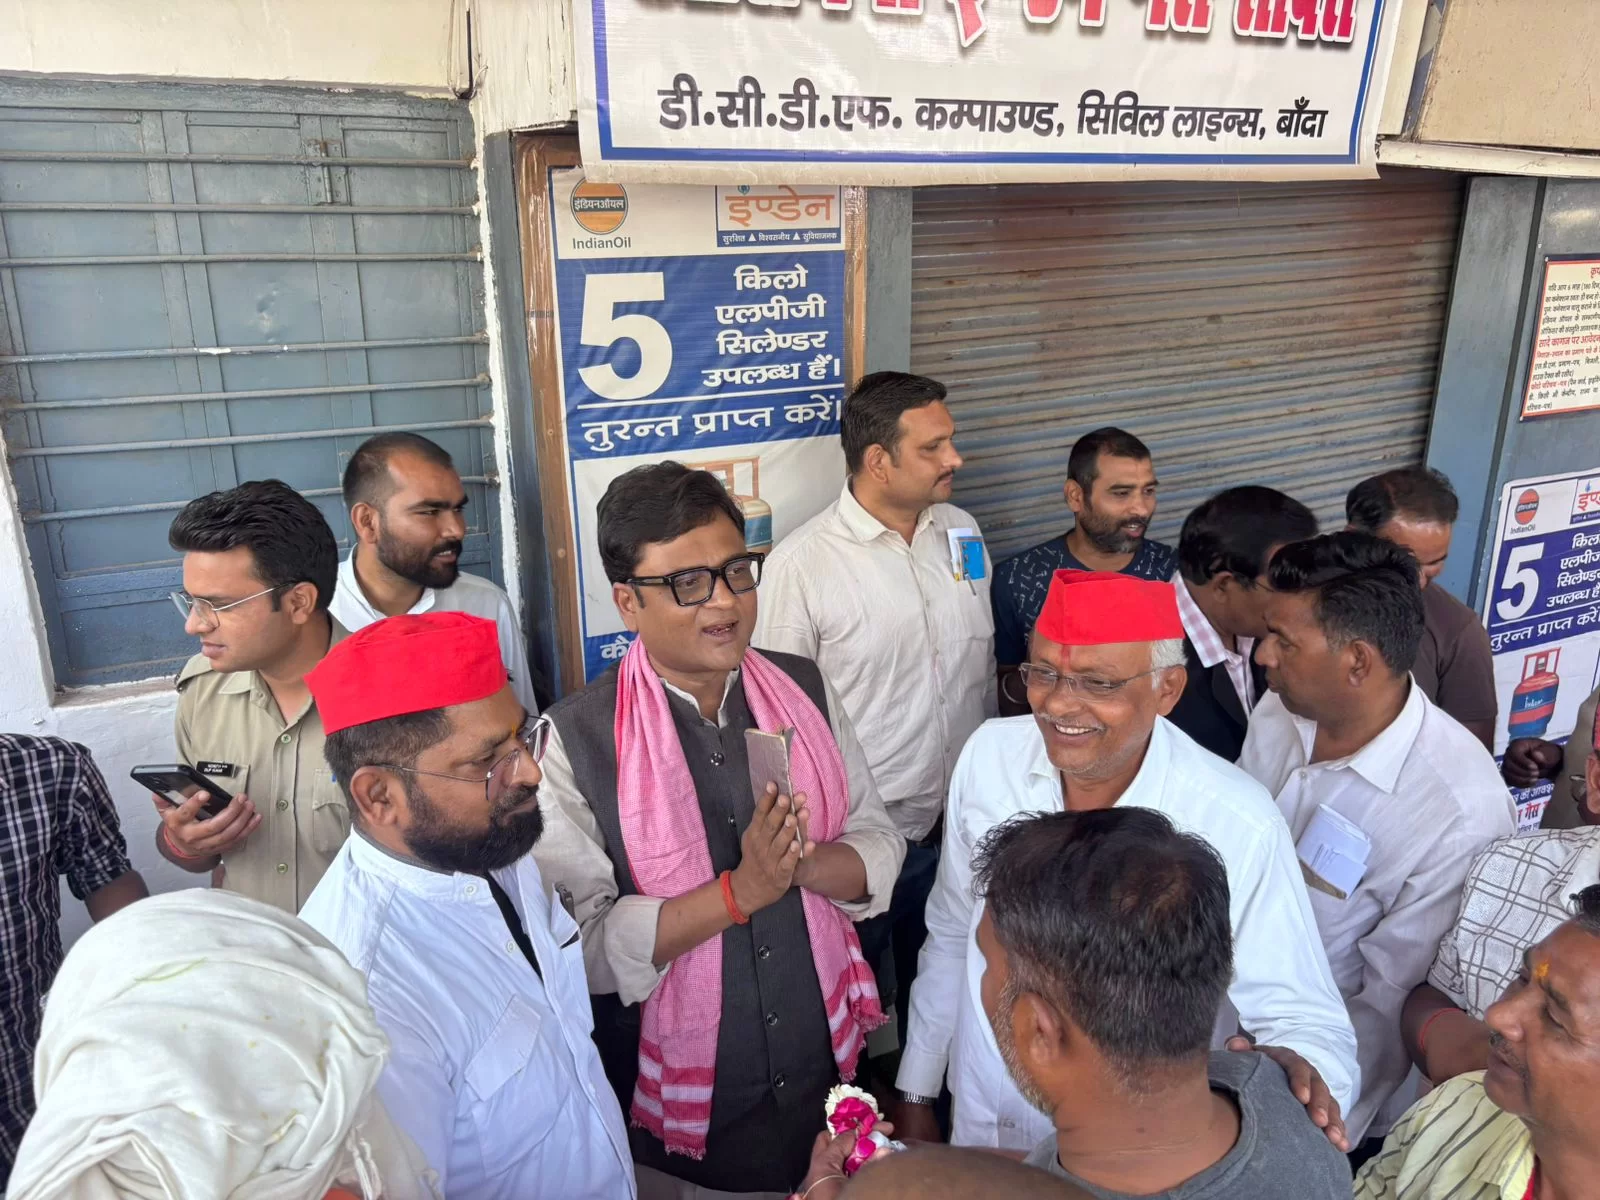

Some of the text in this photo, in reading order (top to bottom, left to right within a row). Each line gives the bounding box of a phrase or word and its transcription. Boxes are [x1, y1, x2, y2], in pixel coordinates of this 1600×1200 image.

[657, 73, 1328, 142] डी.सी.डी.एफ. कम्पाउण्ड, सिविल लाइन्स, बाँदा
[725, 185, 835, 227] इण्डेन
[572, 236, 632, 250] IndianOil
[733, 263, 809, 291] किलो
[715, 293, 827, 324] एलपीजी
[577, 271, 673, 400] 5
[716, 328, 829, 356] सिलेण्डर
[701, 362, 800, 388] उपलब्ध
[582, 415, 682, 451] तुरन्त
[692, 406, 774, 435] प्राप्त
[1496, 542, 1544, 620] 5
[1546, 588, 1590, 607] उपलब्ध
[1537, 616, 1573, 636] प्राप्त
